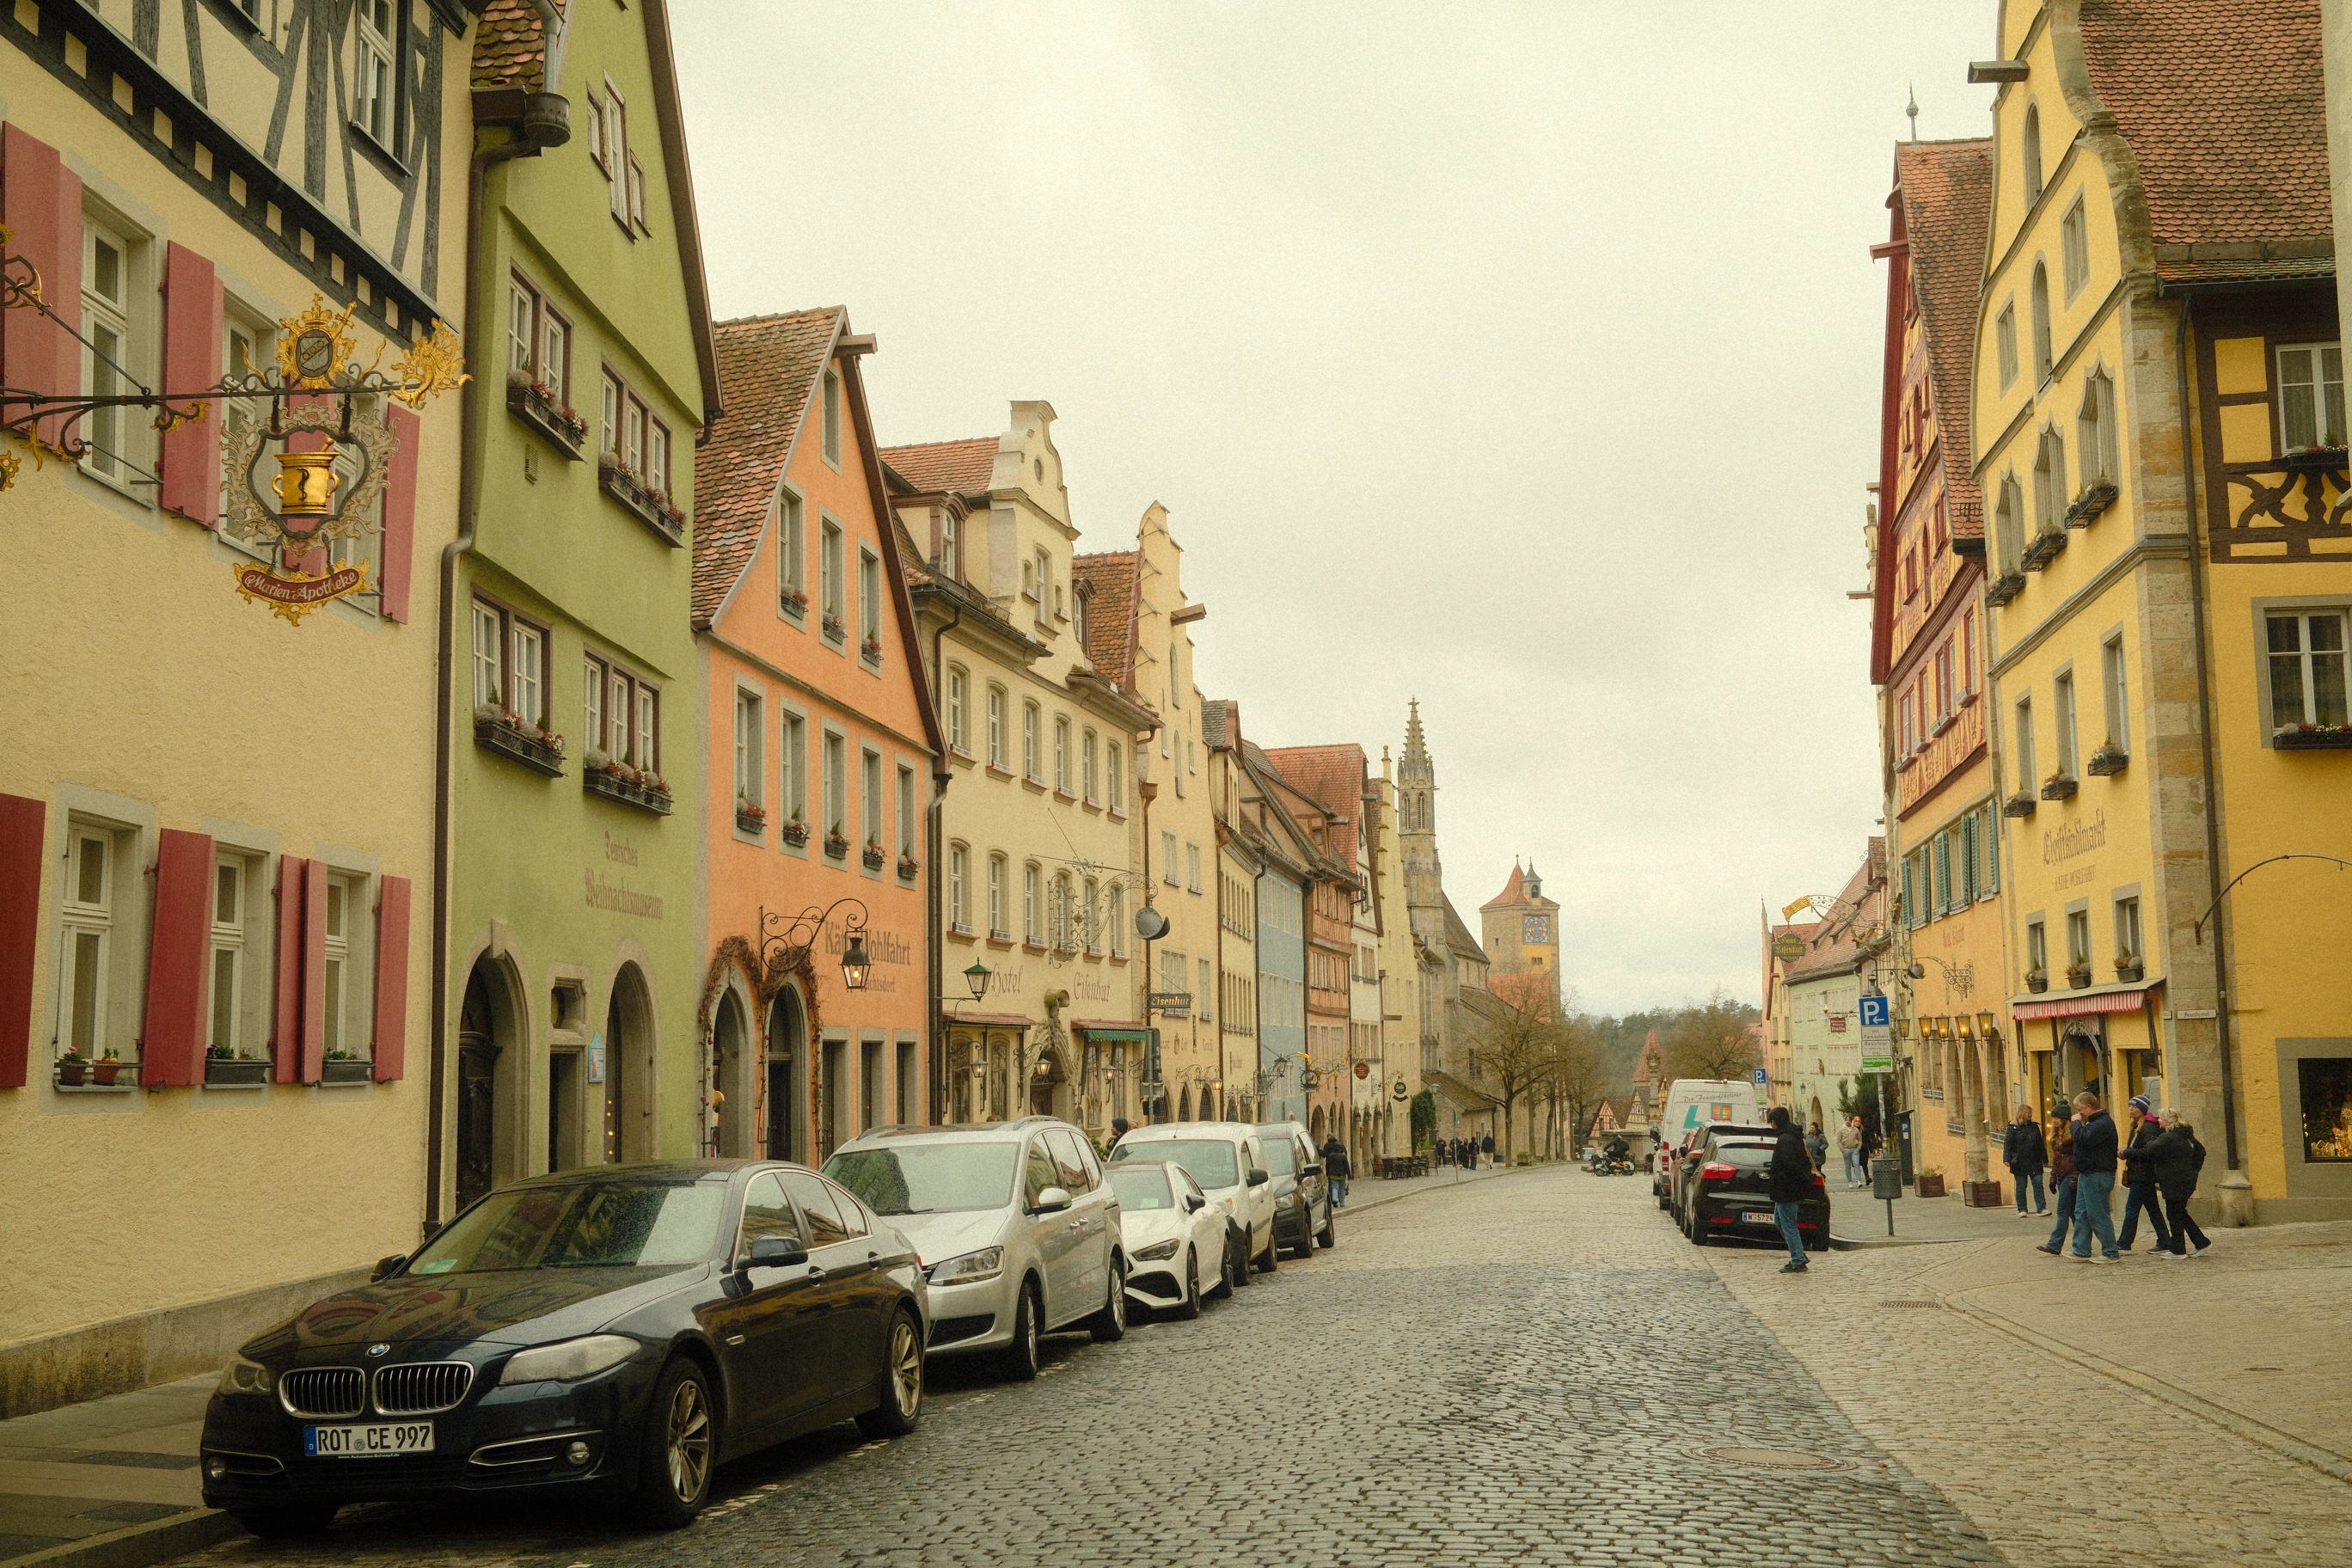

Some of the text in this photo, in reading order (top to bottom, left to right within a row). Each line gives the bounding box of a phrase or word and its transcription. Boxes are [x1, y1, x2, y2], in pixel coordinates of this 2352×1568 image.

[585, 867, 663, 921] Weihnachtsmuseum
[991, 963, 1023, 998] Hotel
[1152, 995, 1190, 1007] Eisenhut
[1863, 1001, 1880, 1025] P
[1755, 1069, 1763, 1083] P
[317, 1429, 352, 1452] ROT
[367, 1427, 392, 1450] CE
[395, 1424, 431, 1449] 997
